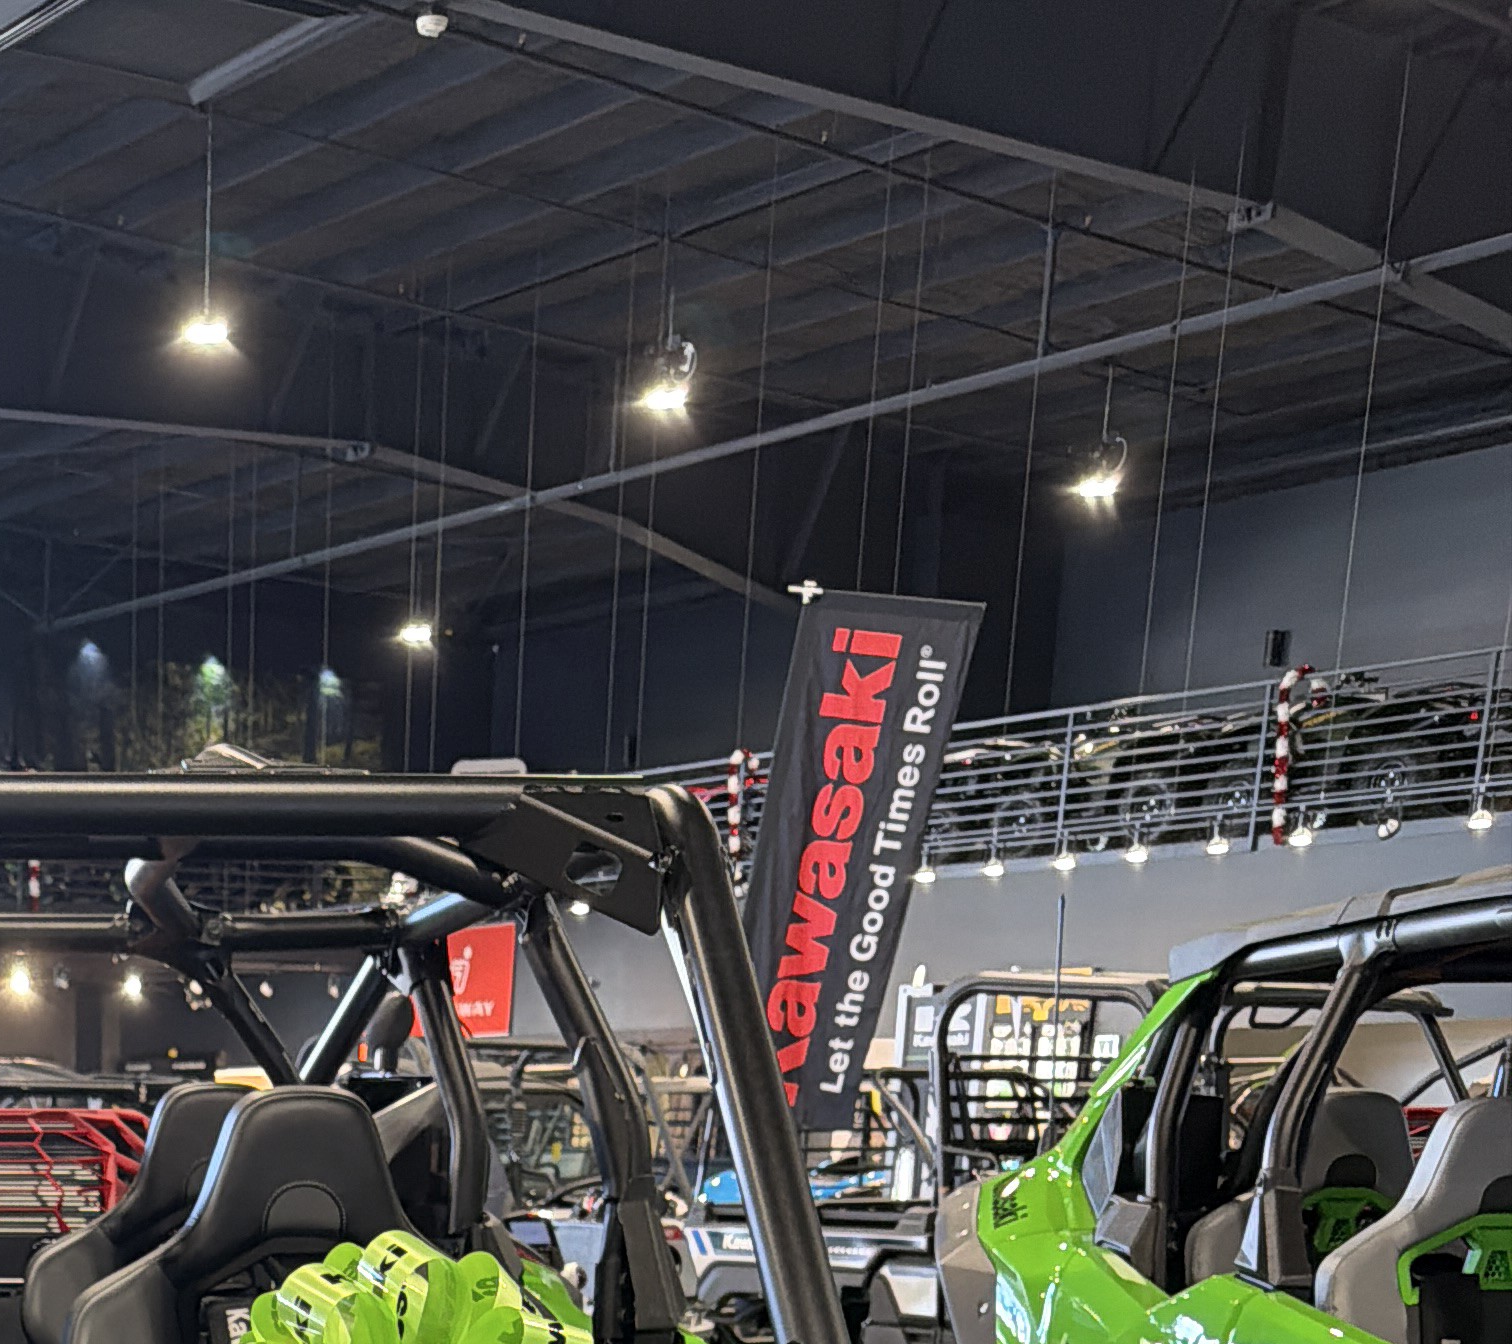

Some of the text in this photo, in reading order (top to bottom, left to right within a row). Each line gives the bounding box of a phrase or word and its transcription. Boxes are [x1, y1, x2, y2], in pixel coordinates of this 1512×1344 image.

[872, 743, 926, 856] Times
[849, 863, 897, 962] Good
[834, 969, 870, 1028] the
[819, 1034, 855, 1094] Let
